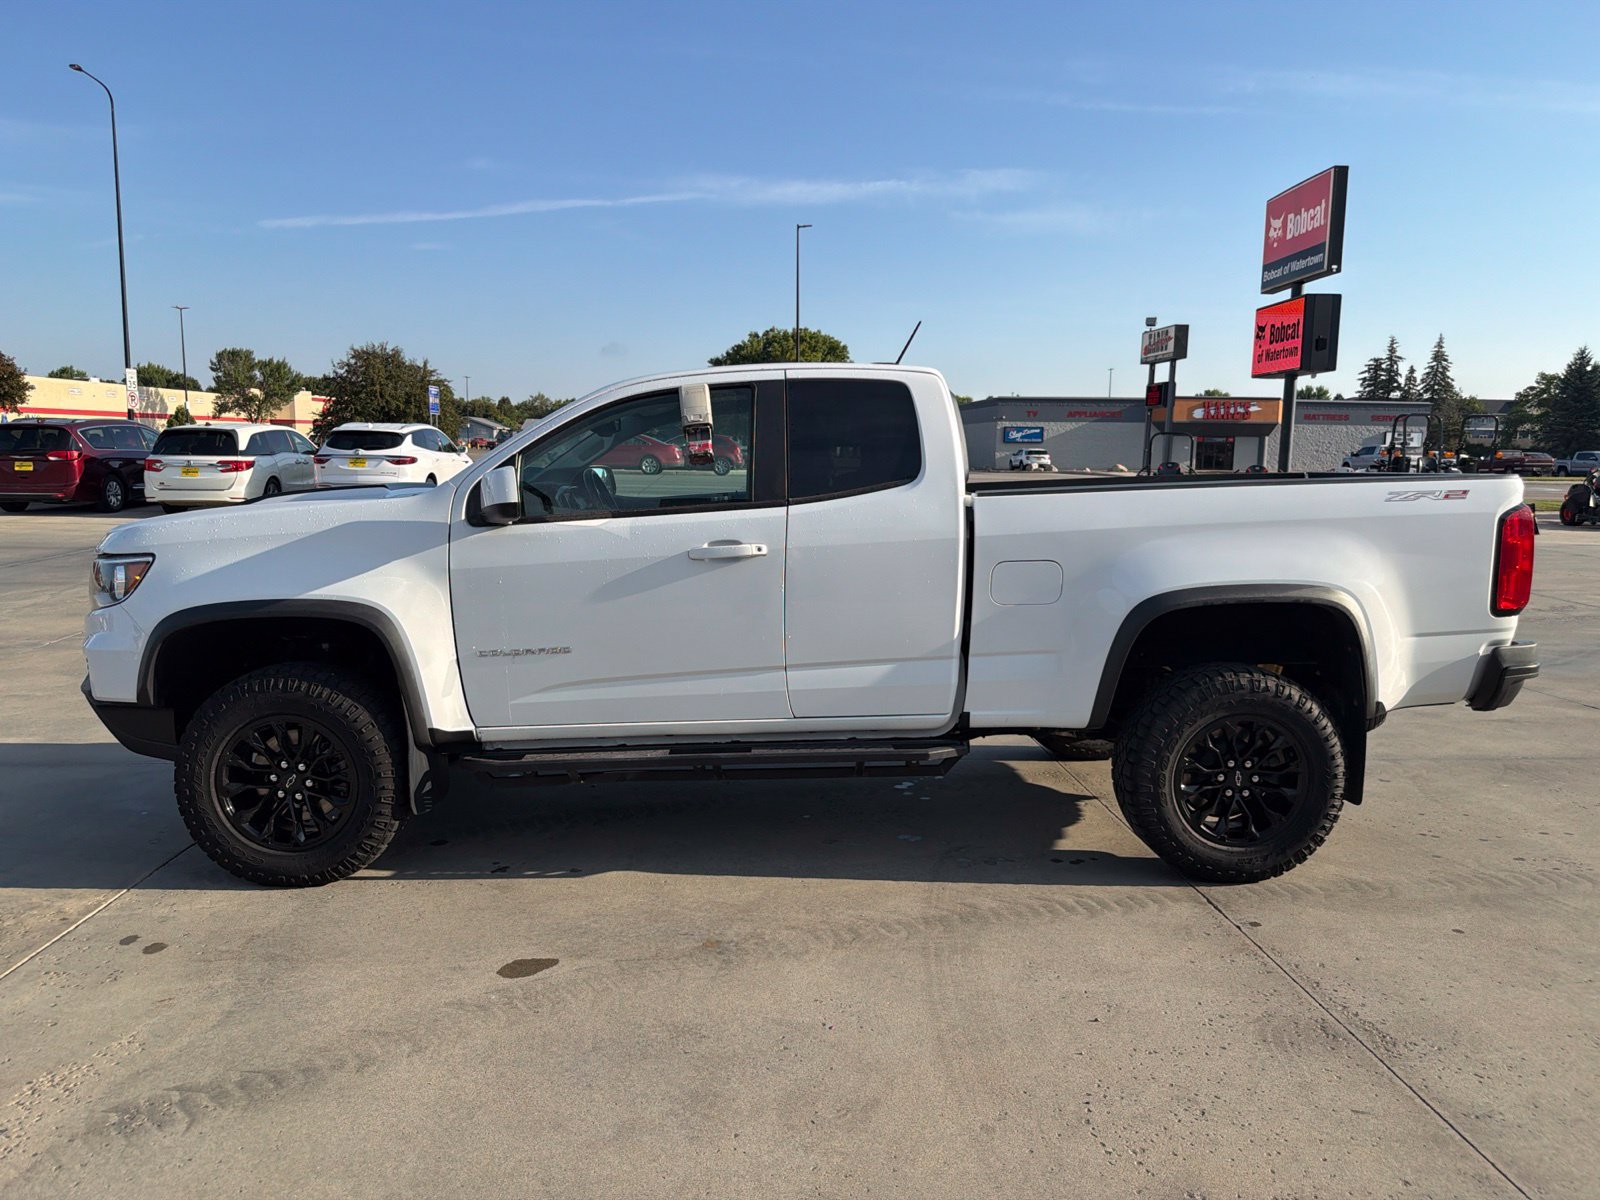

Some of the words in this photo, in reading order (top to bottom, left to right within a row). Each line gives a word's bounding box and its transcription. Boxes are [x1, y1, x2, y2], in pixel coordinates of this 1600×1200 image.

[1286, 198, 1326, 240] Bobcat
[1263, 266, 1283, 282] Bobcat
[1283, 263, 1290, 275] of
[1290, 252, 1324, 272] Watertown
[1269, 318, 1301, 345] Bobcat
[1257, 349, 1265, 364] of
[1265, 345, 1299, 362] Watertown
[128, 381, 137, 389] 35
[1025, 409, 1039, 417] TV
[1303, 413, 1350, 421] MATTRESS
[1384, 489, 1470, 503] ZR2
[476, 646, 573, 658] COLORADO
